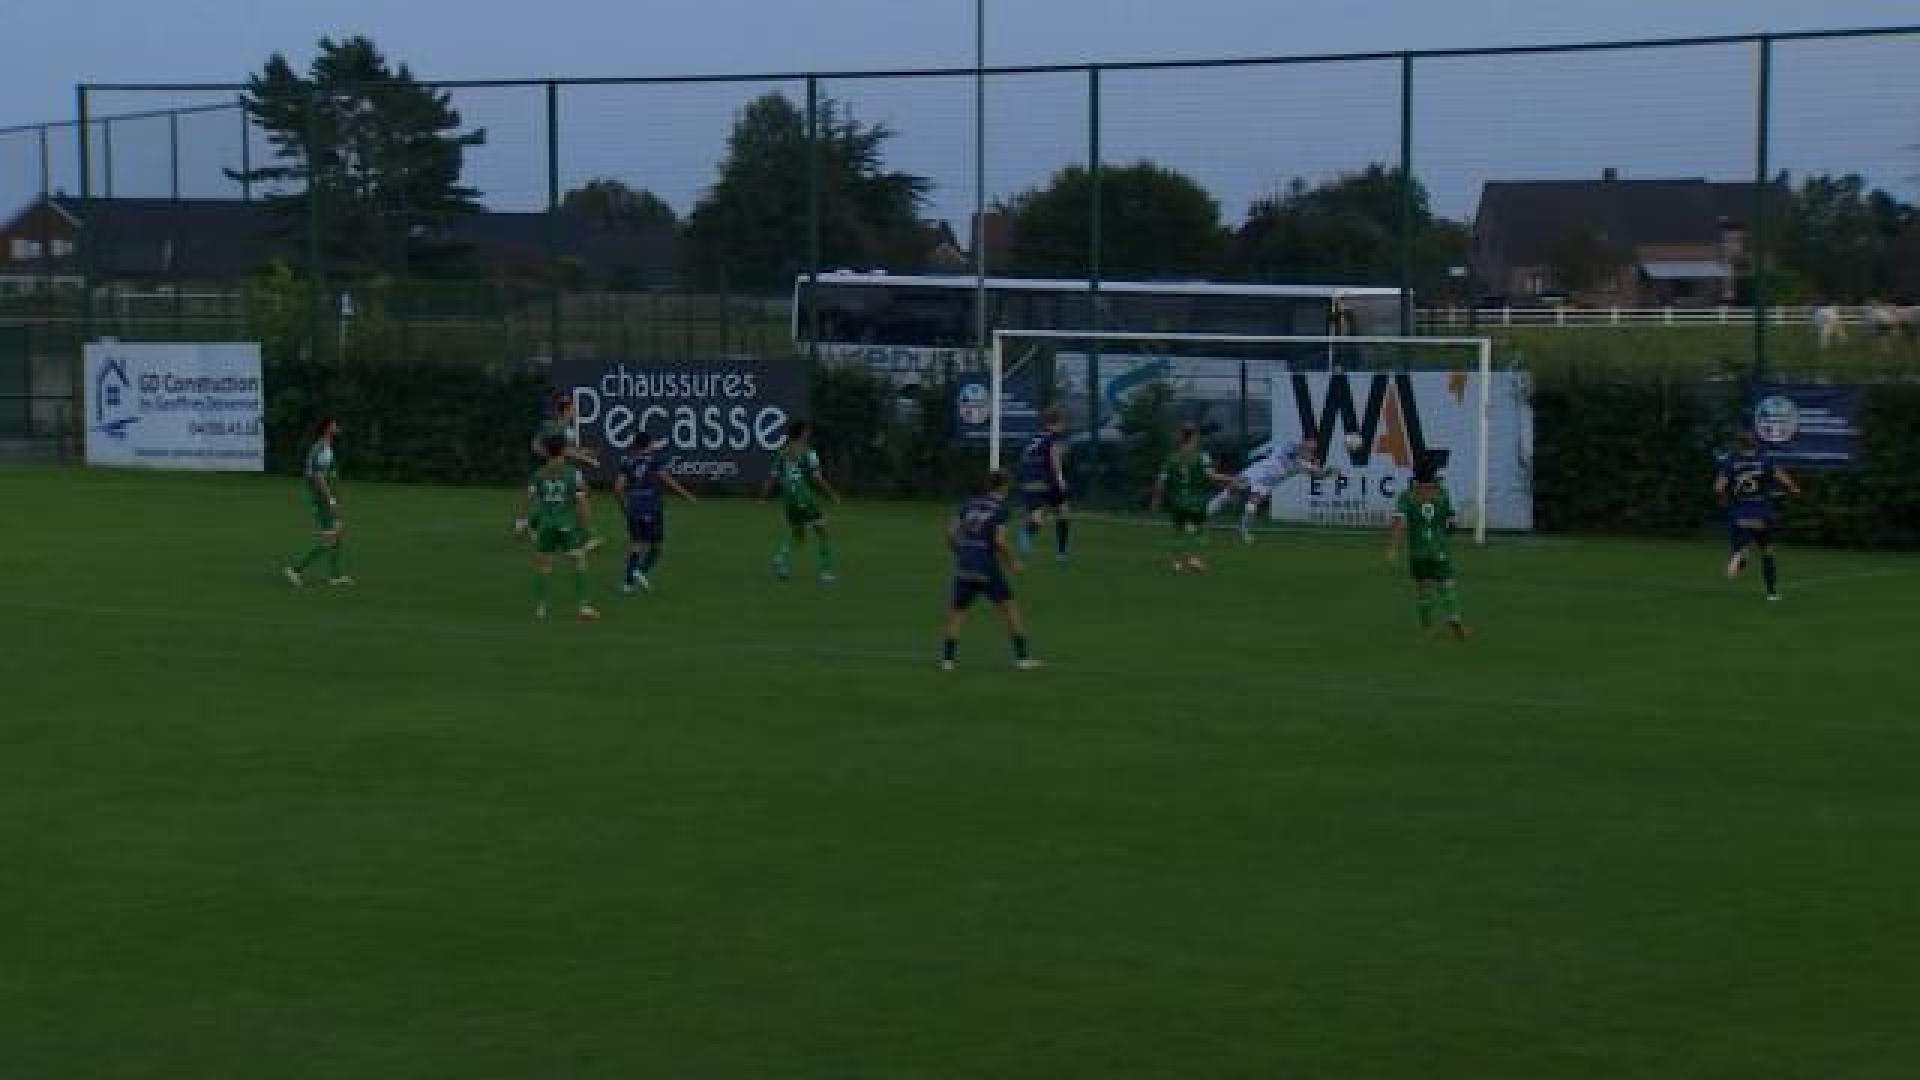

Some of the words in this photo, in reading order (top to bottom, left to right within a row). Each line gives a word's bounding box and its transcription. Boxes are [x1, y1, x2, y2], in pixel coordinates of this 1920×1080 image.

[602, 363, 757, 397] chaussures
[573, 386, 789, 449] Pecasse
[1309, 476, 1394, 498] EPIC
